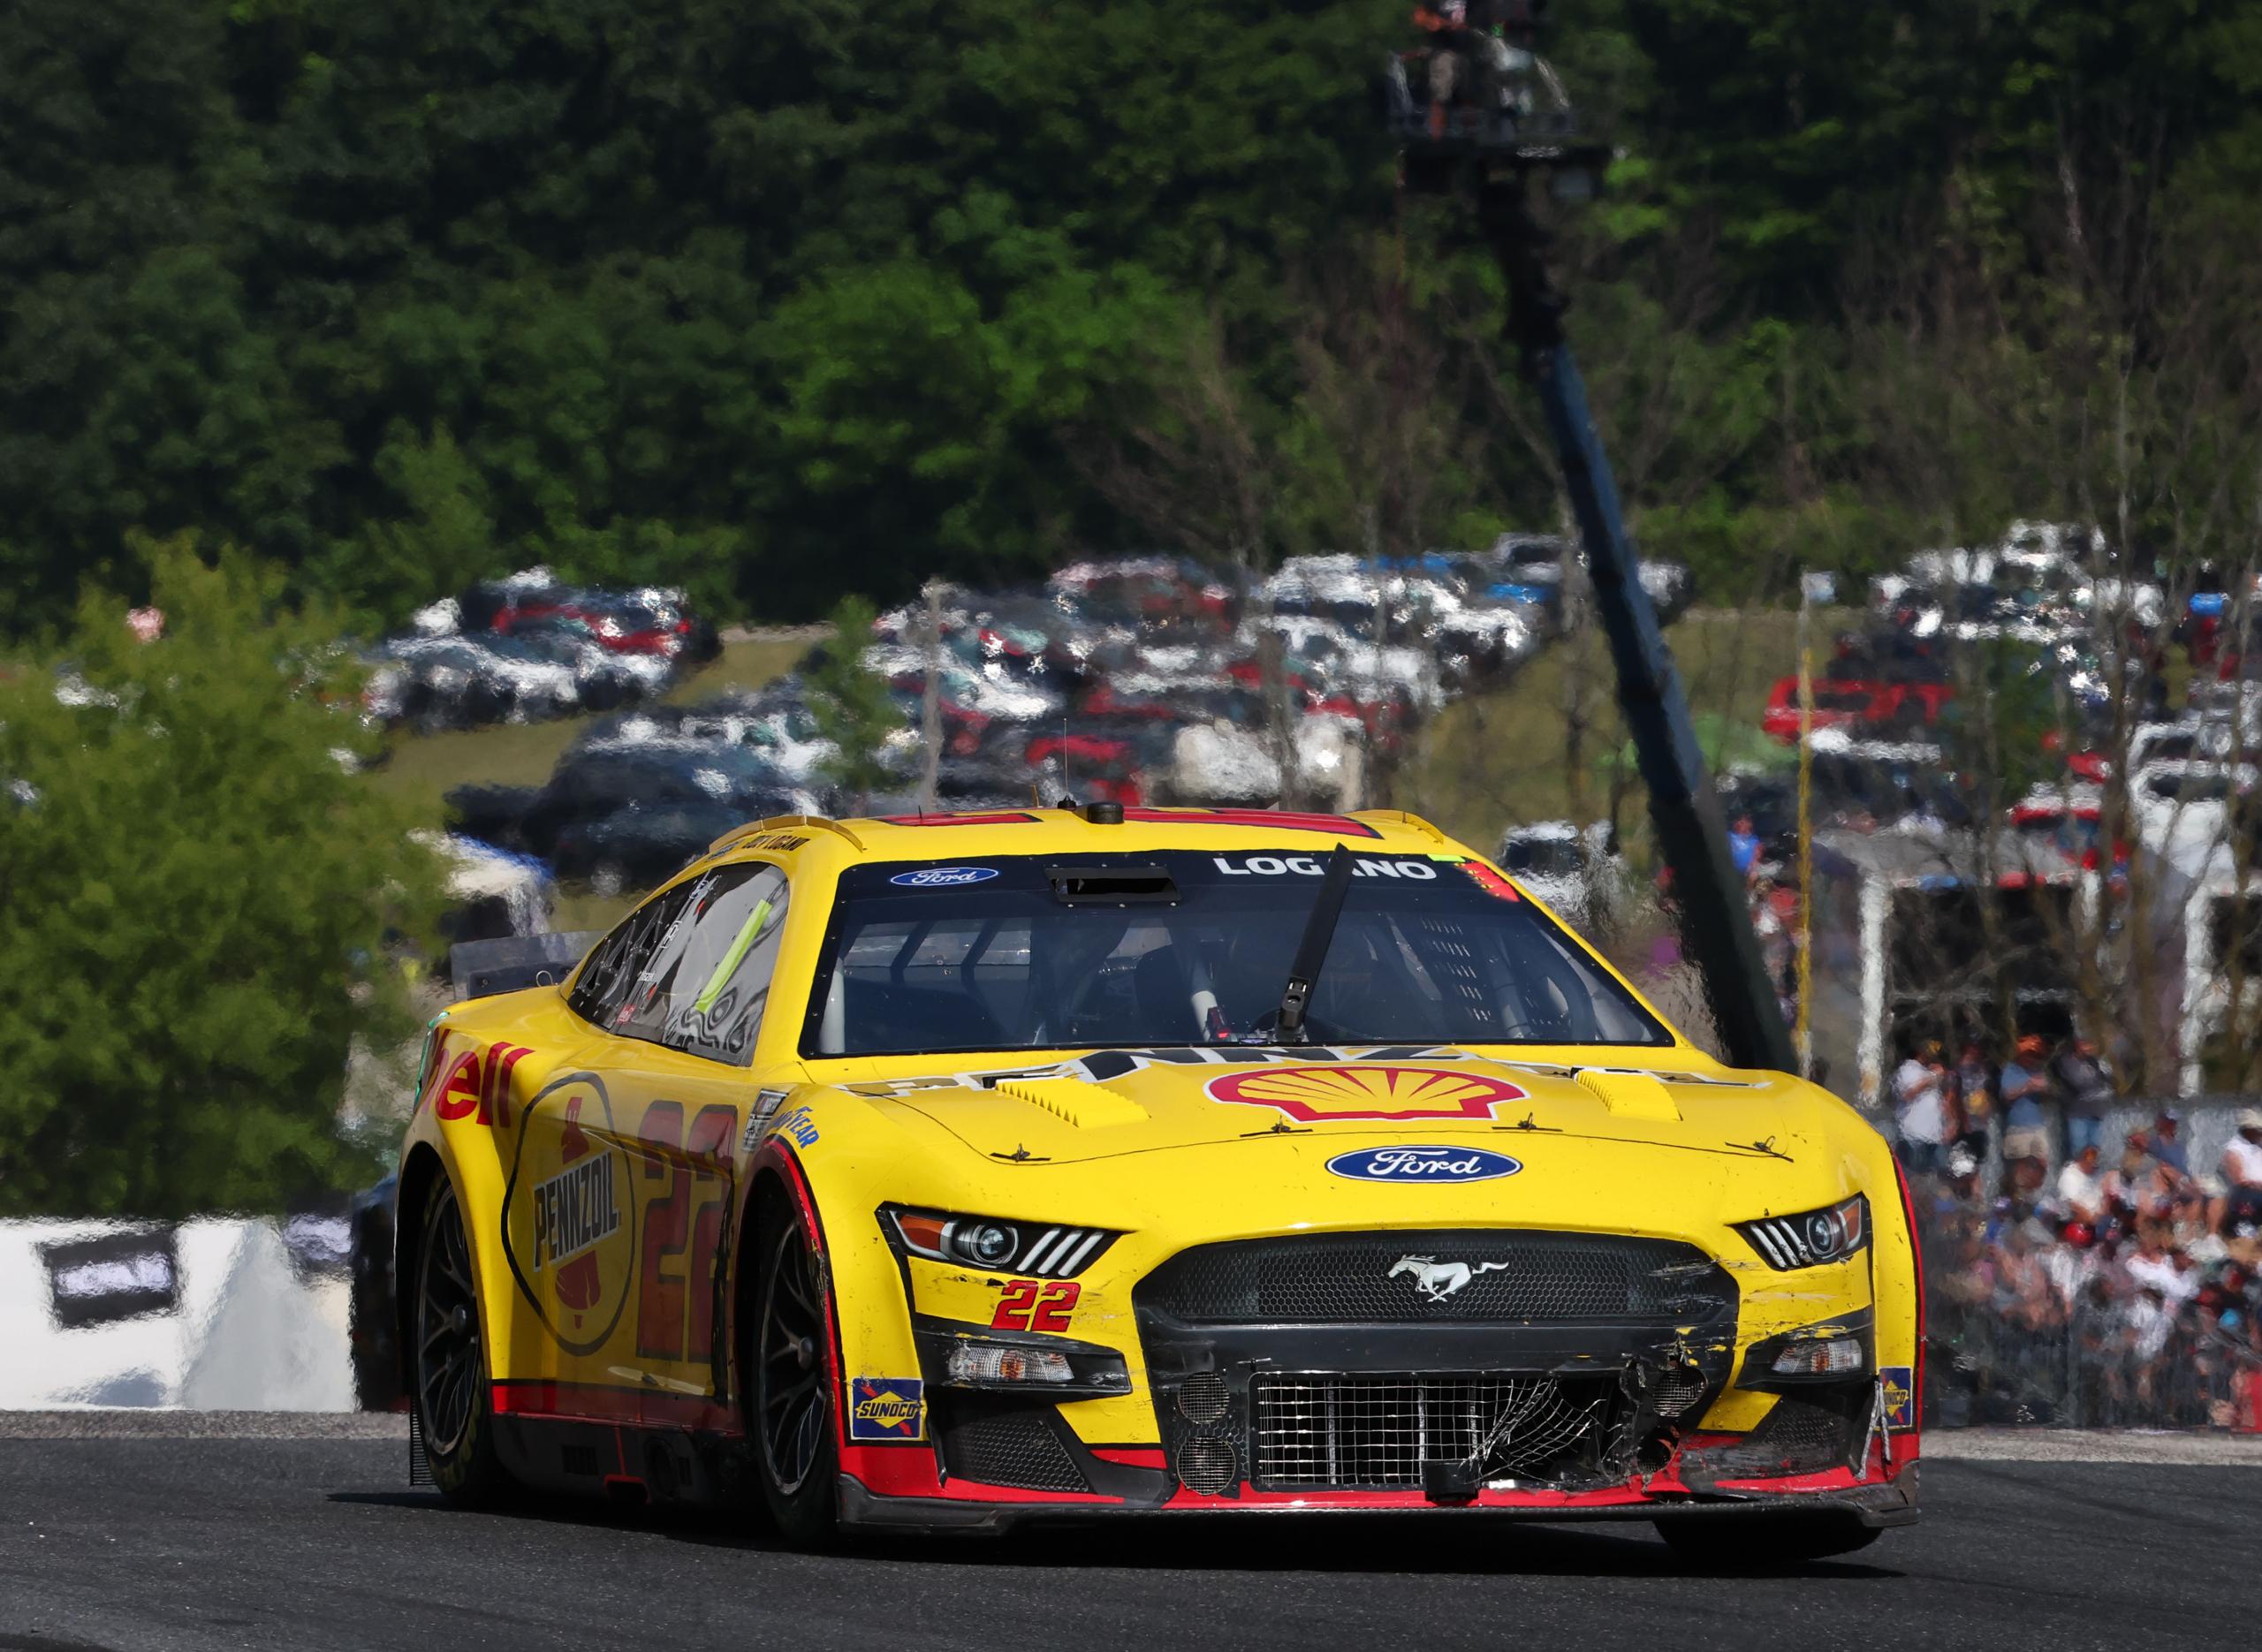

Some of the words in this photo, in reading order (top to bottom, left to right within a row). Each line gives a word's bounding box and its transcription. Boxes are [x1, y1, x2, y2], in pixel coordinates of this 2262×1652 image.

[911, 869, 977, 884] Ford
[1213, 857, 1438, 880] LOGNO
[419, 1027, 535, 1129] hell
[1367, 1151, 1482, 1176] Ford
[533, 1150, 619, 1272] PENNZOIL
[635, 1100, 738, 1365] 22
[990, 1279, 1082, 1332] 22
[858, 1402, 919, 1418] SUNOCO
